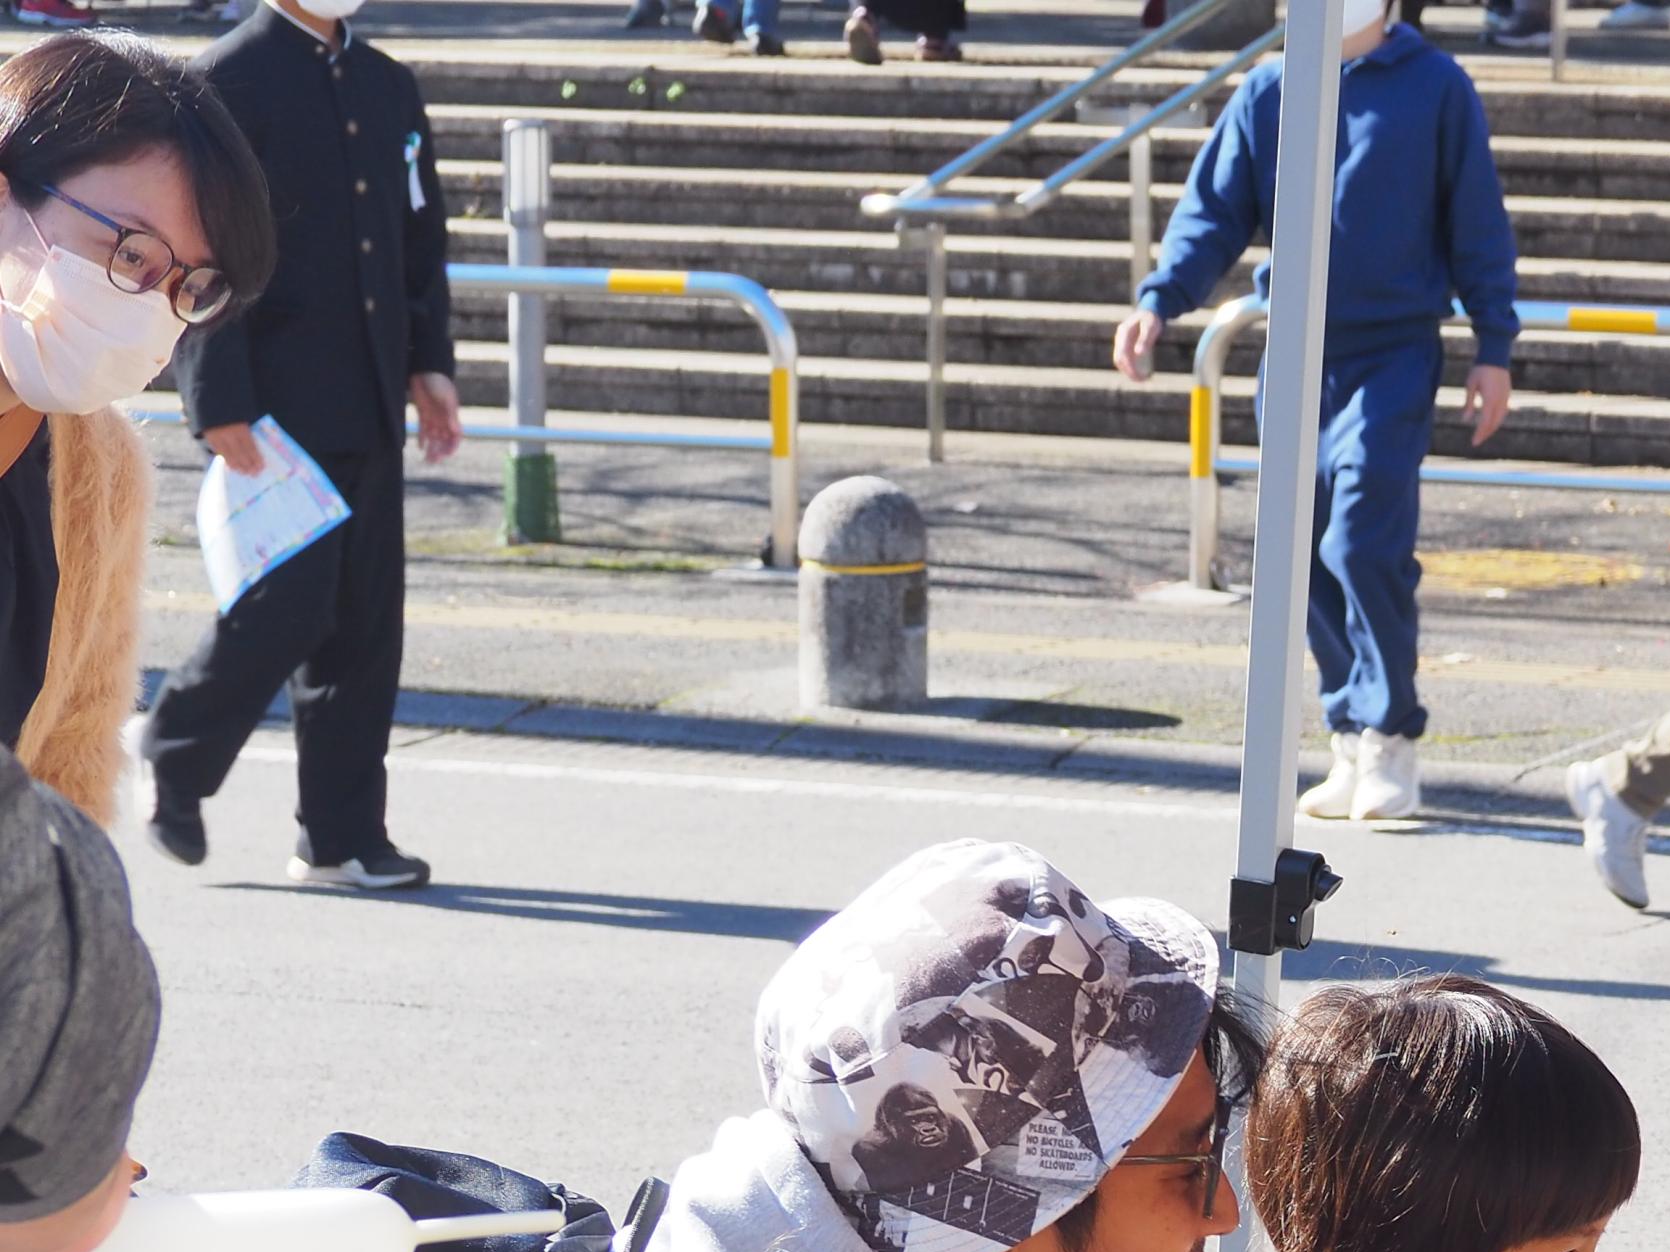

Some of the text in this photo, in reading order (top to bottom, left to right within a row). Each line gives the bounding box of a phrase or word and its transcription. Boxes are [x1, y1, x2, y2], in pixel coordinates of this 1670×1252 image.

[1026, 1134, 1039, 1144] NO
[1025, 1147, 1093, 1161] NO SKATEBOARDS
